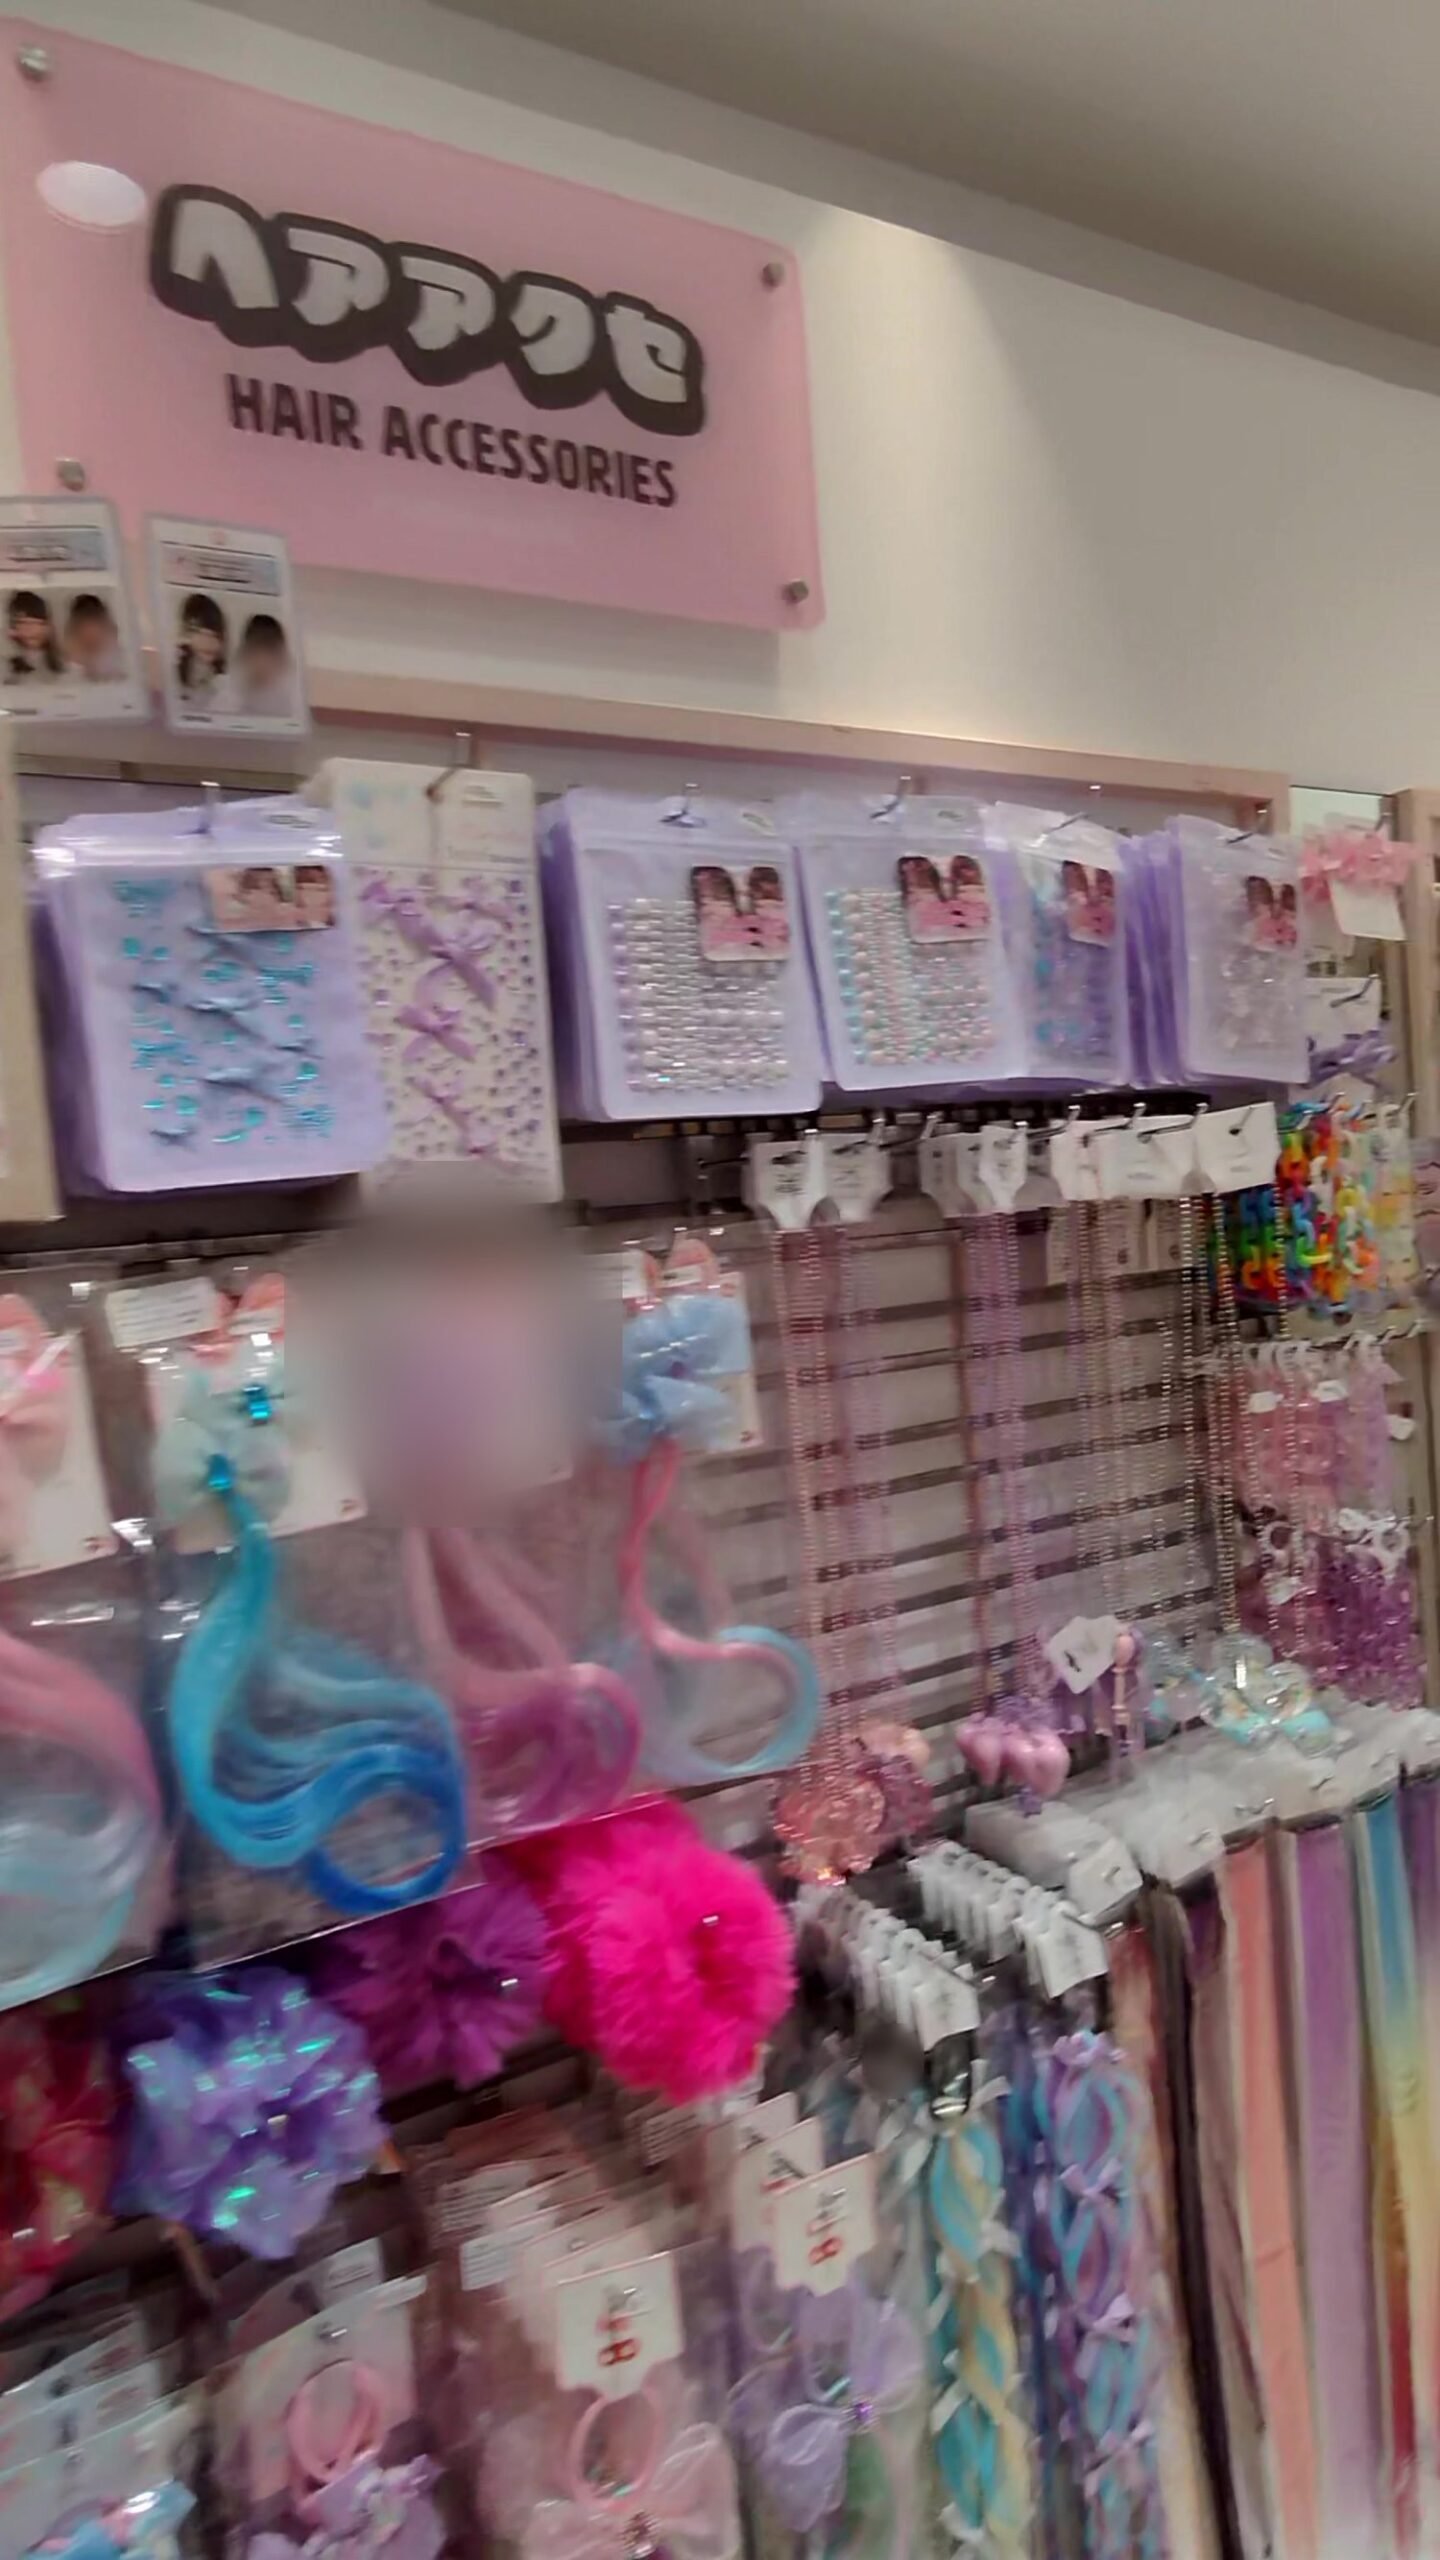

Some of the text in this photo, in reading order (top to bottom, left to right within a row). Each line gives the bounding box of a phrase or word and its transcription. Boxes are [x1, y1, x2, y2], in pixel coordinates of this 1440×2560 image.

[150, 184, 706, 436] ヘアアクセ
[226, 374, 677, 507] HAIR ACCESSORIES
